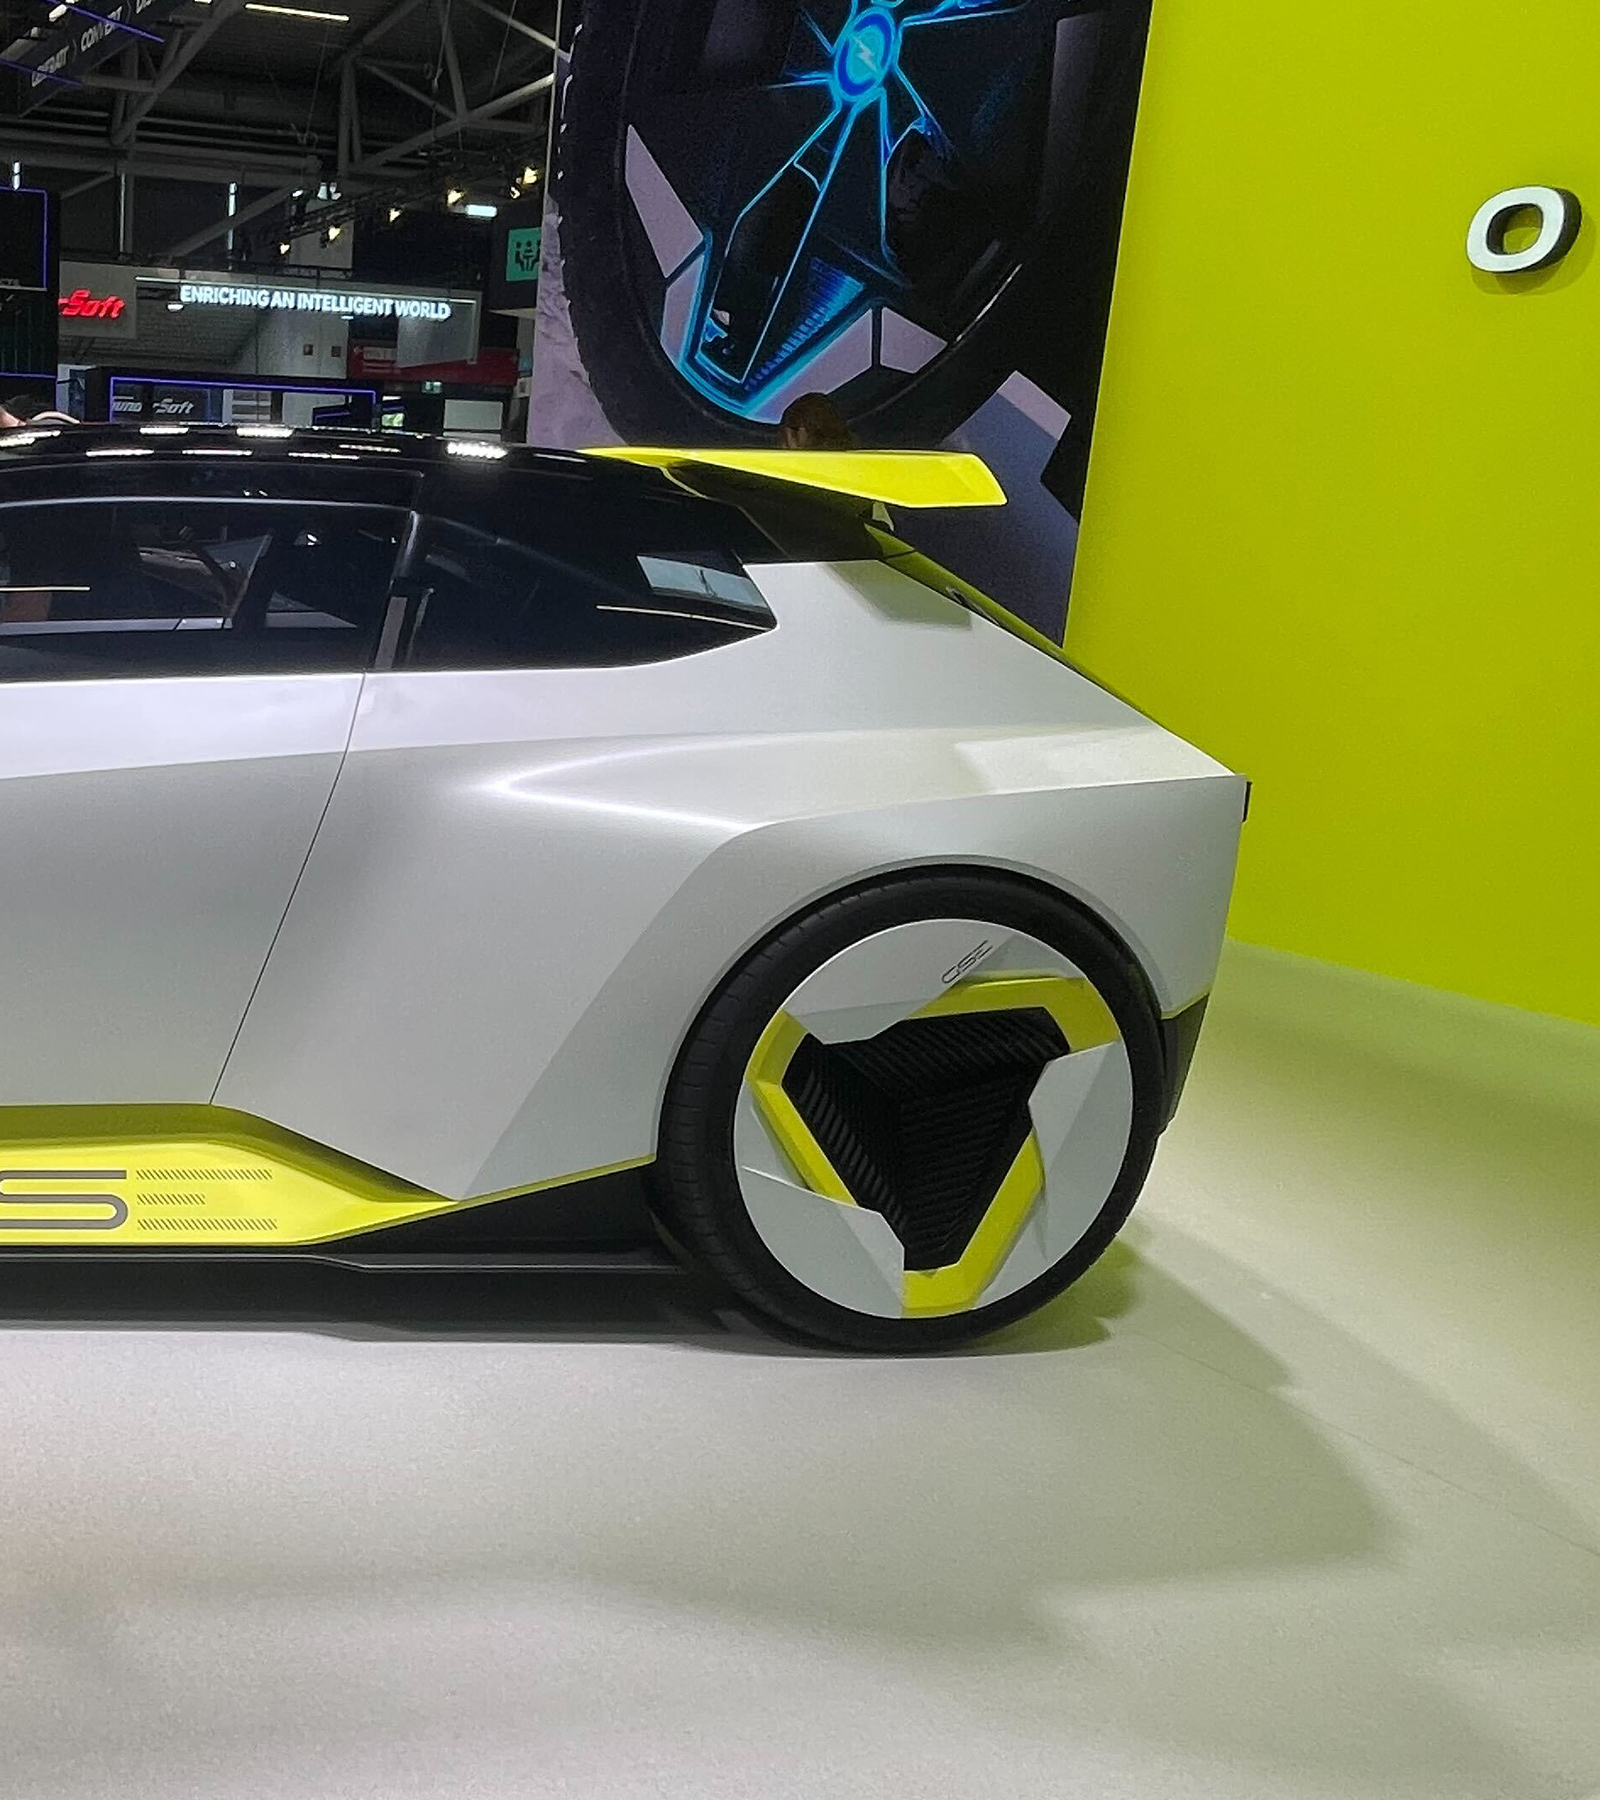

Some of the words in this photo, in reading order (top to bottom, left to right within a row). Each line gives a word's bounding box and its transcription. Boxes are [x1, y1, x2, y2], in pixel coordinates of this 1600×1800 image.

[1466, 185, 1576, 273] O
[180, 285, 270, 308] ENRICHING
[270, 291, 295, 309] AN
[297, 292, 395, 317] INTELLIGENT
[395, 300, 451, 320] WORLD
